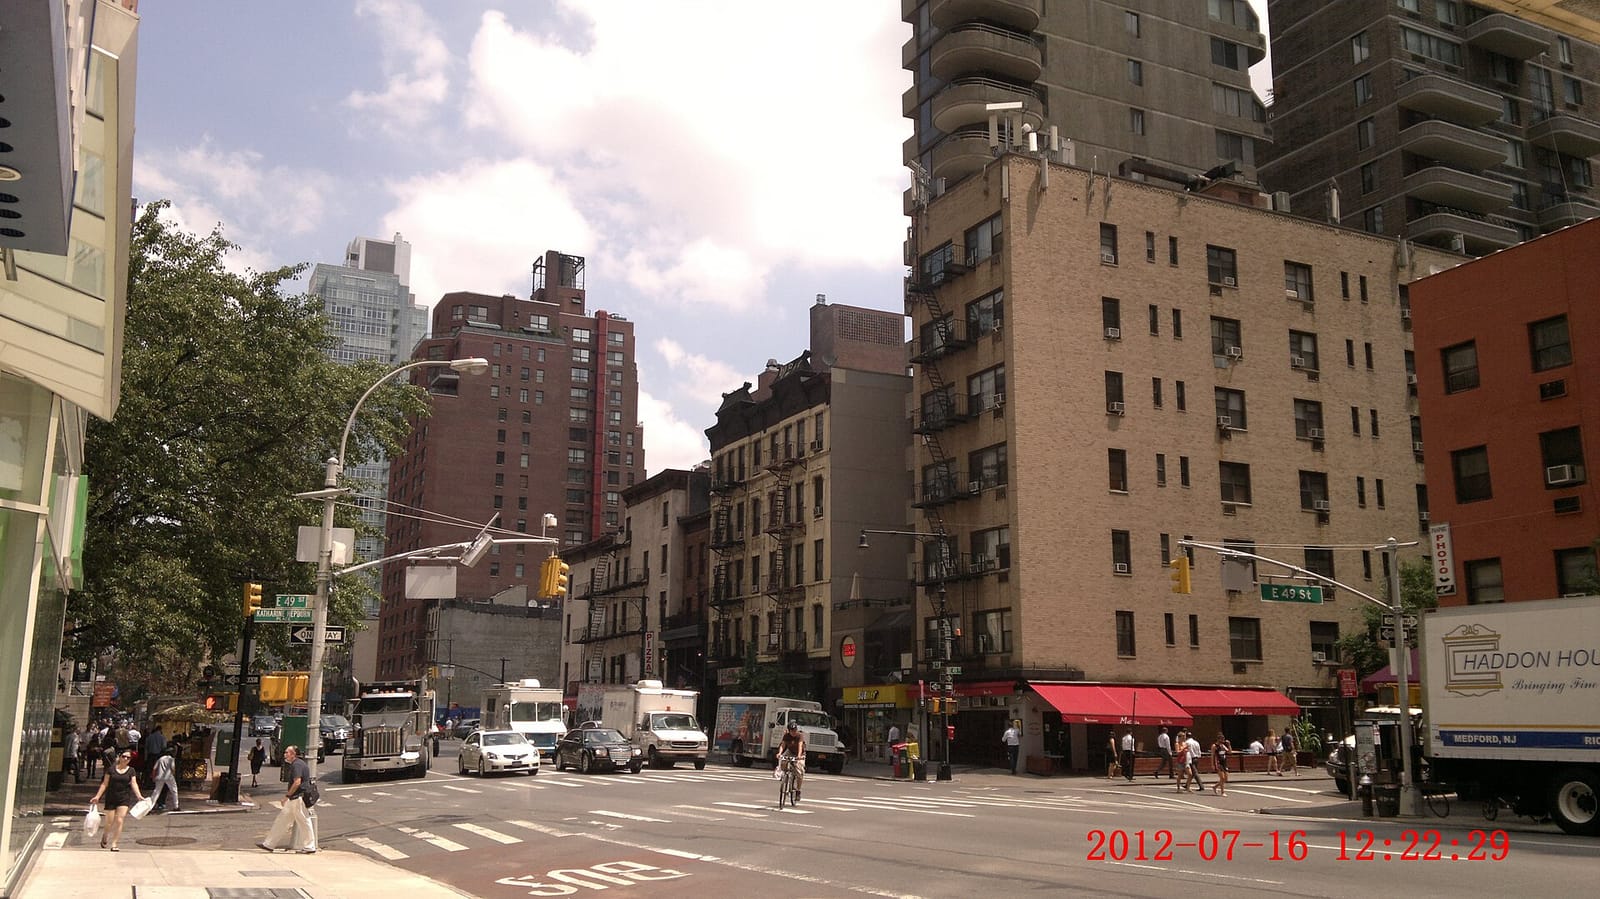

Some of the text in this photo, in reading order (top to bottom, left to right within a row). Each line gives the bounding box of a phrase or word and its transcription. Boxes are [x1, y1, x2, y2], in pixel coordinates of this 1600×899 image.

[1436, 534, 1449, 574] PHOTO
[1272, 587, 1312, 600] E 49 St
[276, 596, 282, 607] E
[284, 596, 296, 607] 49
[301, 631, 313, 639] ON
[1464, 650, 1551, 670] HADDON
[1512, 677, 1597, 694] Bringing Fine
[1454, 734, 1517, 744] MEDFORD, NJ
[495, 861, 693, 896] BUS
